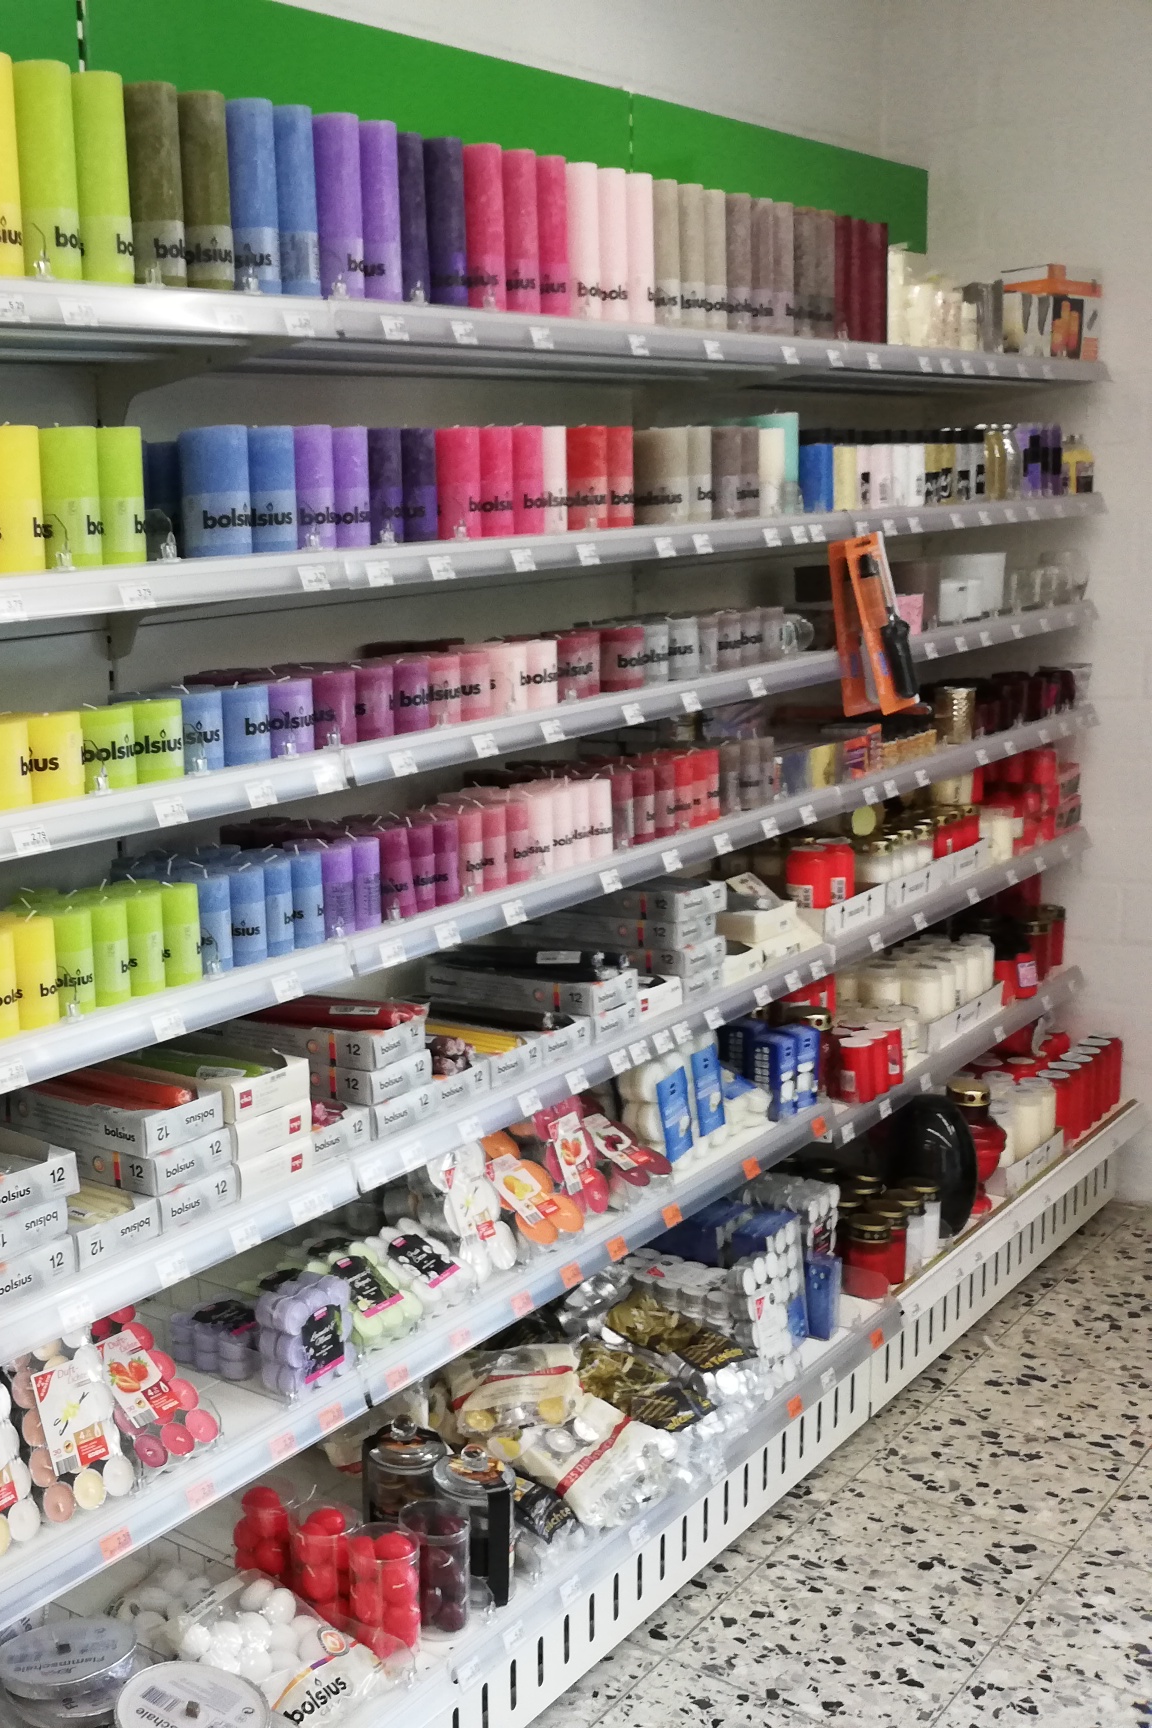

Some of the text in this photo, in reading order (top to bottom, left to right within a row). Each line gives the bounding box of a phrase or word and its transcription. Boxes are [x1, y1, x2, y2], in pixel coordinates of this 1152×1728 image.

[31, 832, 46, 842] 2.79
[569, 991, 582, 1003] 12
[346, 1043, 361, 1056] 12
[380, 1038, 402, 1055] bolsius
[414, 1060, 425, 1073] 12
[345, 1077, 359, 1090] 12
[378, 1073, 404, 1089] bolsius
[419, 1093, 429, 1107] 12
[185, 1107, 215, 1127] bolsius
[384, 1107, 409, 1127] bolsius
[104, 1124, 136, 1143] bolsius
[157, 1125, 170, 1141] 12
[352, 1120, 364, 1134] 12
[209, 1141, 222, 1155] 12
[314, 1135, 341, 1152] bolsius
[50, 1167, 65, 1184] 12
[129, 1164, 144, 1179] 12
[165, 1157, 195, 1178] bolsius
[214, 1179, 228, 1195] 12
[170, 1197, 201, 1218] bolsius
[25, 1210, 59, 1233] bolsius
[120, 1216, 151, 1237] bolsius
[91, 1239, 104, 1257] 12
[49, 1252, 64, 1270] 12
[283, 1675, 348, 1728] bolsius
